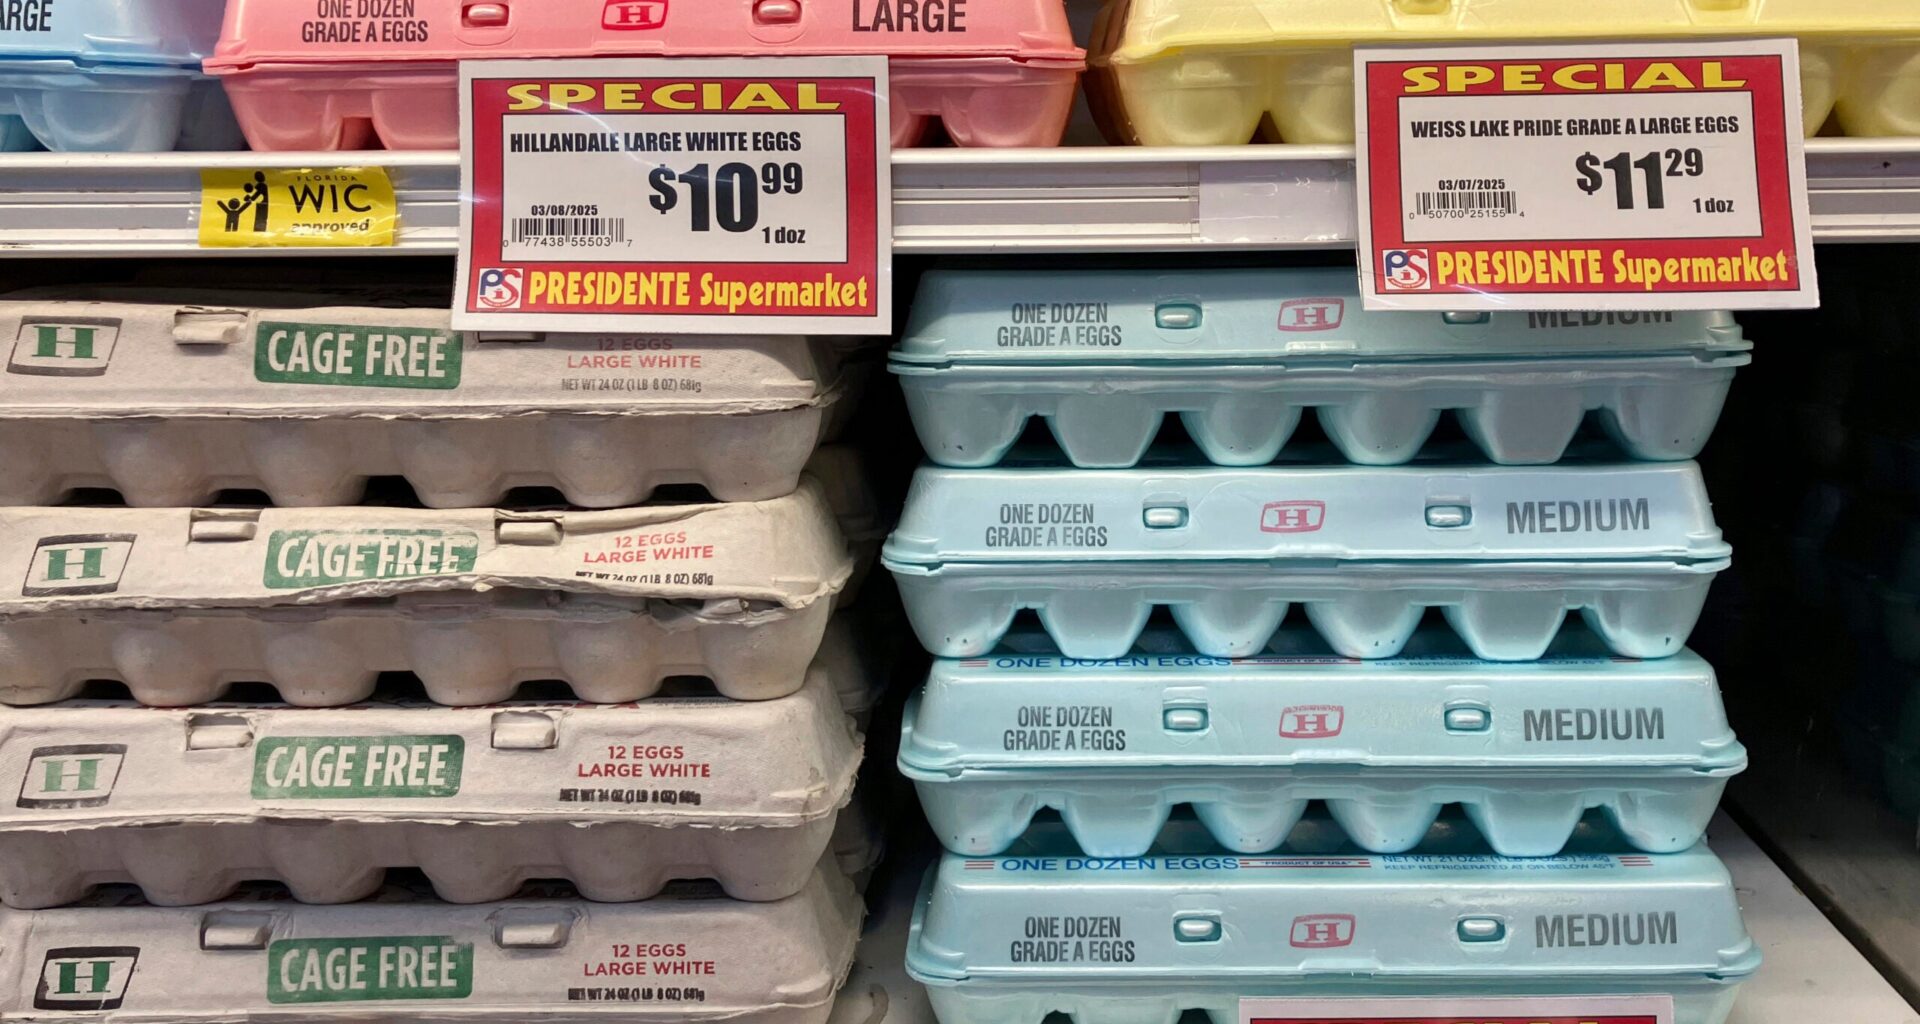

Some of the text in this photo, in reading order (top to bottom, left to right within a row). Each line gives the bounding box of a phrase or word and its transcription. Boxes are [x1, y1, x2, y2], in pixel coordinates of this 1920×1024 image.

[318, 0, 415, 18] ONE DOZEN
[851, 0, 967, 33] LARGE
[302, 21, 428, 42] GRADE A EGGS
[1402, 62, 1747, 93] SPECIAL
[507, 83, 842, 111] SPECIAL
[1410, 116, 1740, 138] WEISS LAKE PRIDE GRADE A LARGE EGGS
[510, 132, 802, 153] HILLANDALE LARGE WHITE EGGS
[1438, 178, 1505, 191] 03/07/2025
[288, 184, 372, 214] WIC
[1692, 198, 1734, 214] 1 doz
[530, 204, 598, 217] 03/08/2025
[1428, 210, 1465, 220] 50700
[1470, 209, 1506, 218] 25155
[290, 218, 370, 234] approved
[762, 227, 806, 244] 1 doz
[524, 236, 565, 248] 77438
[571, 236, 612, 248] 55503
[1436, 249, 1789, 291] PRESIDENTE Supermarket
[528, 272, 868, 313] PRESIDENTE Supermarket
[1011, 302, 1108, 324] ONE DOZEN
[1293, 307, 1328, 325] H
[32, 326, 98, 359] H
[598, 338, 673, 351] 12 EGGS
[996, 326, 1122, 347] GRADE A EGGS
[268, 330, 448, 378] CAGE FREE
[567, 354, 702, 369] LARGE WHITE
[562, 378, 578, 390] NET
[582, 378, 596, 390] WT
[599, 378, 610, 390] 24
[612, 379, 624, 391] OZ
[637, 379, 648, 391] LB
[653, 379, 658, 391] 8
[1000, 504, 1094, 524] ONE DOZEN
[1275, 508, 1311, 527] H
[1506, 498, 1650, 534] MEDIUM
[614, 532, 686, 548] 12 EGGS
[984, 526, 1108, 548] GRADE A EGGS
[46, 547, 108, 582] H
[278, 534, 458, 578] CAGE FREE
[584, 546, 714, 564] LARGE WHITE
[665, 574, 672, 584] 8
[996, 656, 1232, 668] ONE DOZEN EGGS
[1017, 706, 1112, 727] ONE DOZEN
[1294, 714, 1328, 732] H
[1524, 708, 1664, 742] MEDIUM
[1003, 730, 1126, 750] GRADE A EGGS
[608, 746, 684, 759] 12 EGGS
[40, 758, 102, 792] H
[266, 744, 449, 788] CAGE FREE
[578, 764, 710, 778] LARGE WHITE
[1002, 858, 1238, 871] ONE DOZEN EGGS
[1024, 916, 1121, 938] ONE DOZEN
[1306, 924, 1341, 941] H
[1535, 910, 1678, 948] MEDIUM
[612, 944, 686, 958] 12 EGGS
[1010, 940, 1136, 963] GRADE A EGGS
[54, 960, 116, 994] H
[280, 945, 458, 993] CAGE FREE
[584, 961, 716, 976] LARGE WHITE
